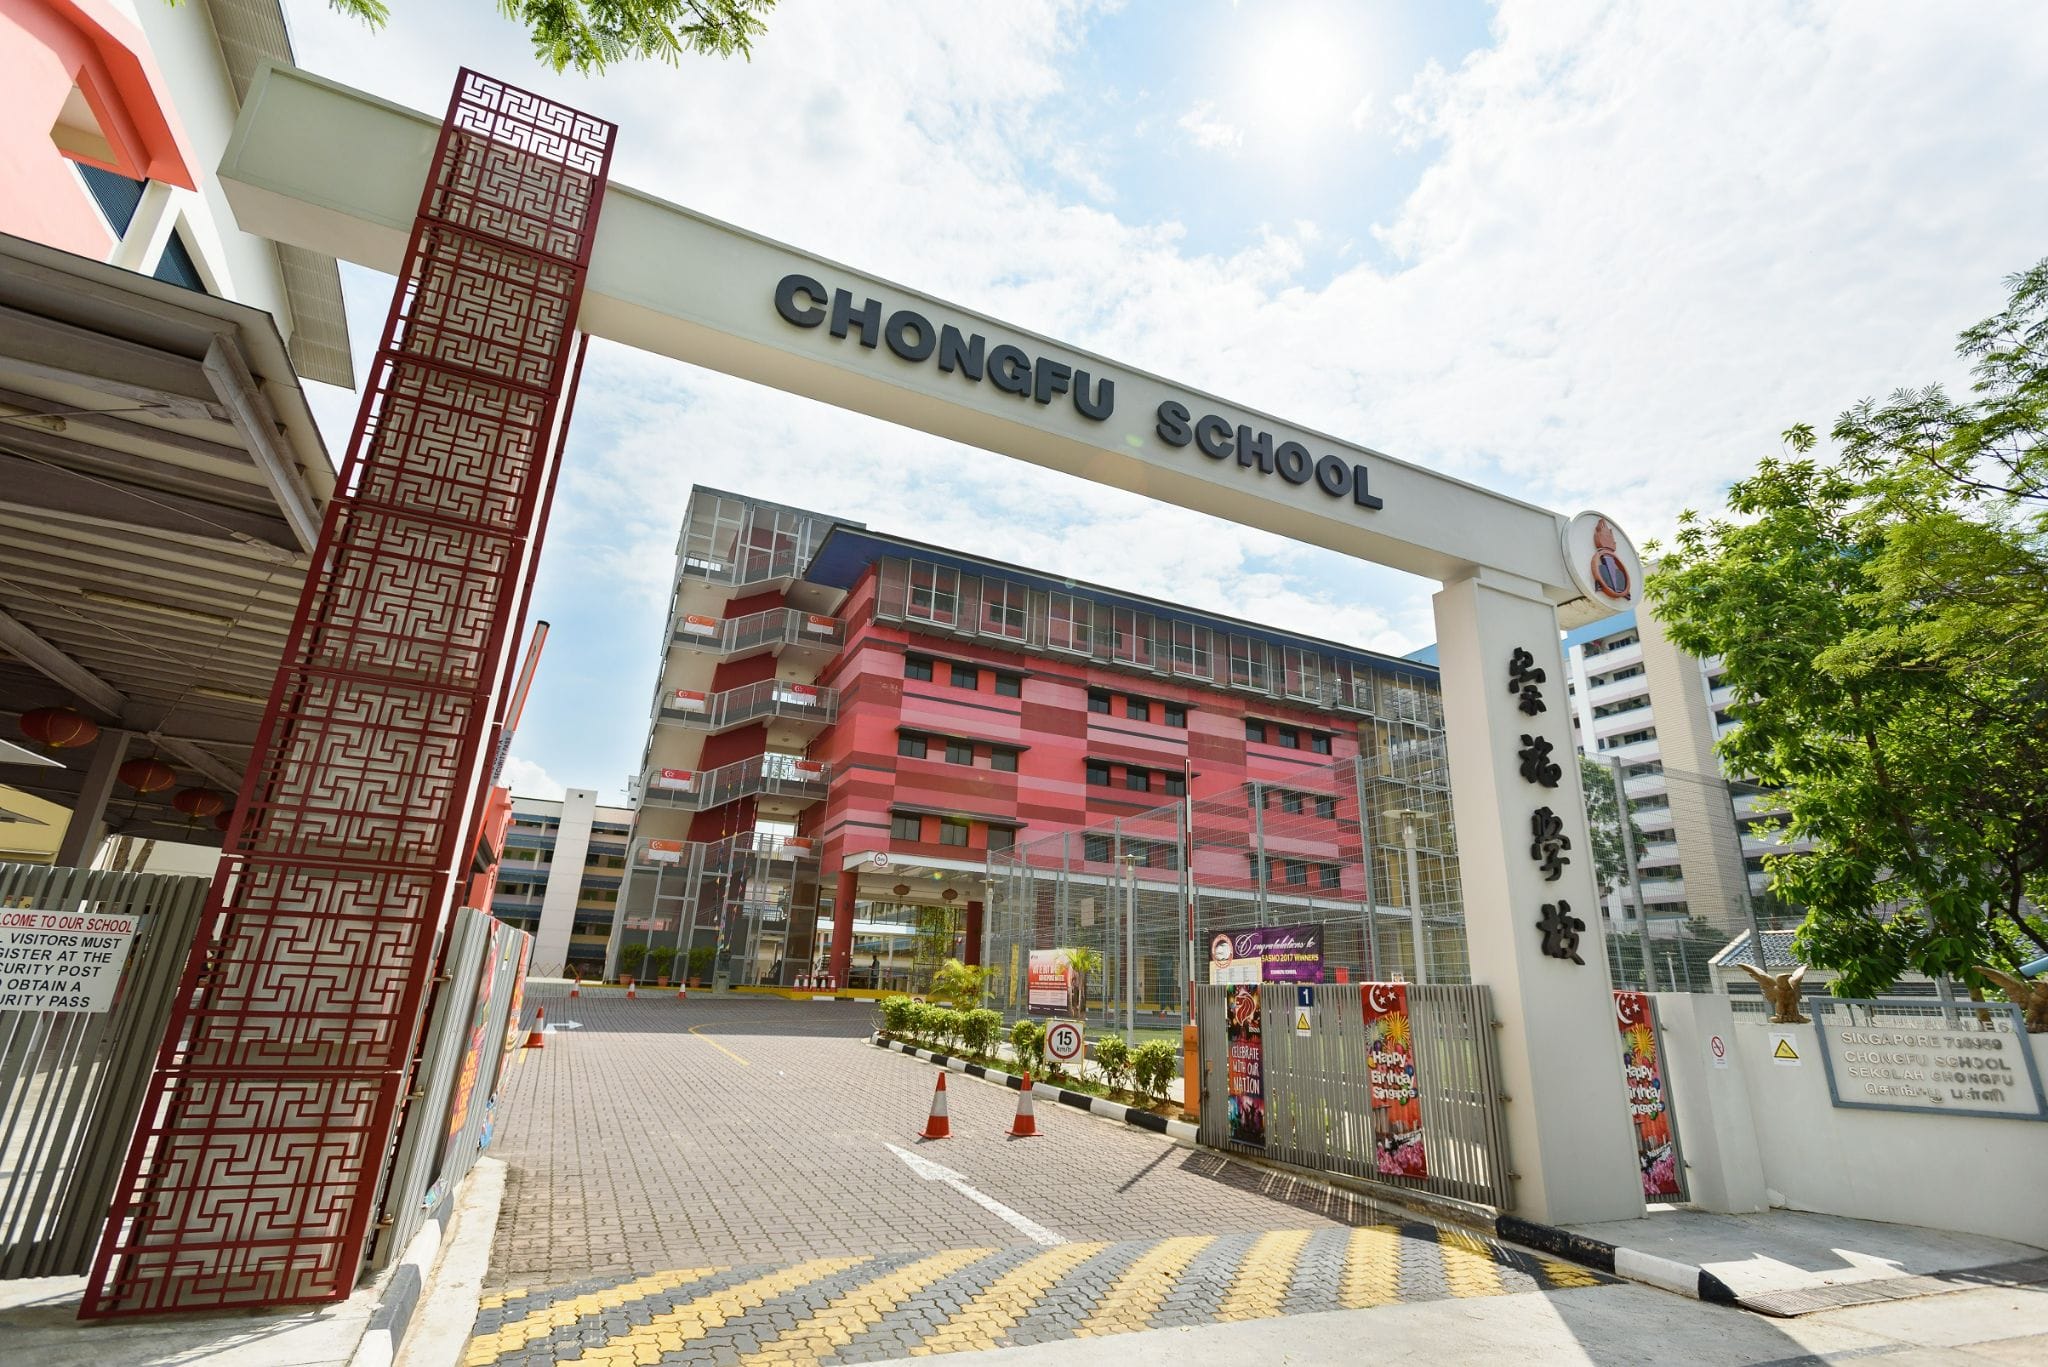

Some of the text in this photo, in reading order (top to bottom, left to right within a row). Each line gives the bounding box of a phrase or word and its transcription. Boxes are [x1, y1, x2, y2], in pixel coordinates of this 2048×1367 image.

[774, 274, 1383, 511] CHONGFU SCHOOL
[41, 915, 57, 928] TO
[59, 916, 84, 930] OUR
[87, 918, 132, 933] SCHOOL
[11, 933, 78, 947] VISITORS
[80, 936, 122, 950] MUST
[56, 951, 78, 962] AT
[83, 951, 113, 964] THE
[1281, 953, 1293, 962] 2017
[58, 964, 102, 978] POST
[7, 979, 67, 992] OBTAIN
[70, 981, 81, 992] A
[49, 995, 90, 1008] PASS
[1303, 988, 1309, 1004] 1
[1057, 1030, 1072, 1046] 15
[1841, 1032, 1941, 1049] SINGAPORE
[1231, 1044, 1260, 1060] CELEBRATE
[1373, 1050, 1406, 1067] Happy
[1844, 1050, 2012, 1071] CHONGFU SCHOOL
[1247, 1062, 1260, 1077] OUR
[1848, 1066, 2015, 1087] SEKOLAH CHONGFU
[1233, 1076, 1260, 1095] NATION
[1371, 1070, 1413, 1089] Birthday
[1629, 1084, 1661, 1103] irthday
